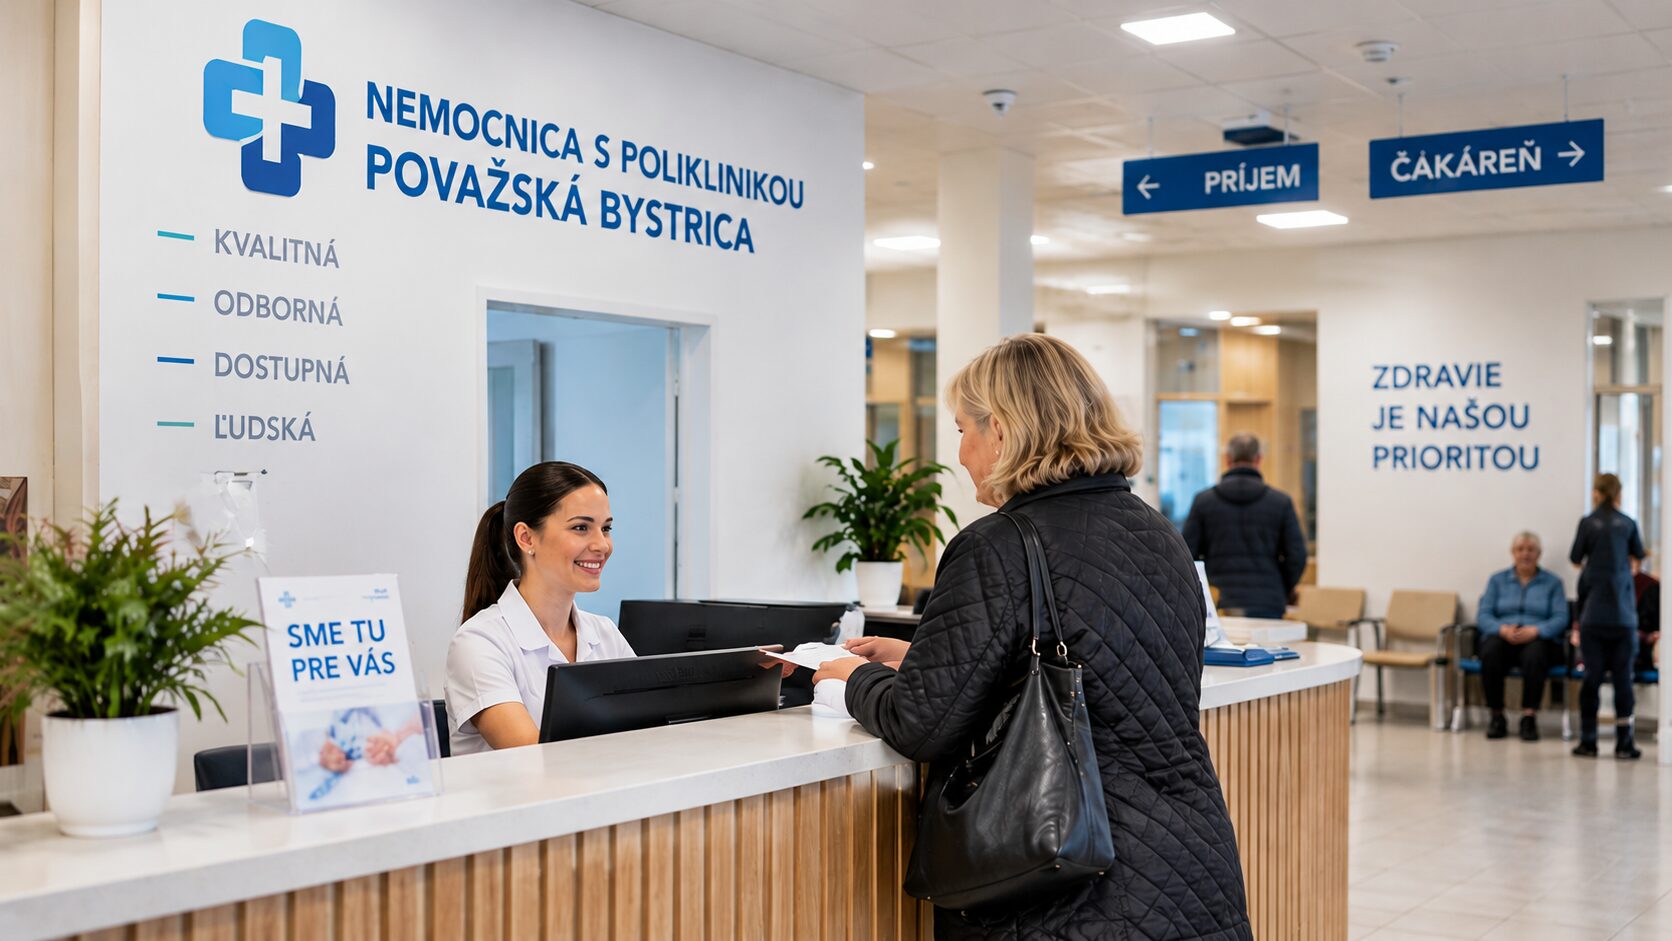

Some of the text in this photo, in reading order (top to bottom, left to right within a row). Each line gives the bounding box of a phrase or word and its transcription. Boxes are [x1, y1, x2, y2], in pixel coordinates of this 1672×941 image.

[366, 80, 804, 210] NEMOCNICA S POLIKLINIKOU
[1204, 162, 1301, 194] PRÍJEM
[366, 143, 755, 254] POVAŽSKÁ BYSTRICA
[215, 228, 340, 269] KVALITNÁ
[213, 289, 344, 327] ODBORNÁ
[214, 351, 350, 385] DOSTUPNÁ
[1373, 362, 1502, 390] ZDRAVIE
[214, 411, 316, 442] ĽUDSKÁ
[1372, 398, 1530, 430] JE NAŠOU
[1373, 444, 1540, 471] PRIORITOU
[287, 619, 386, 649] SME TU
[291, 647, 396, 682] PRE VÁS
